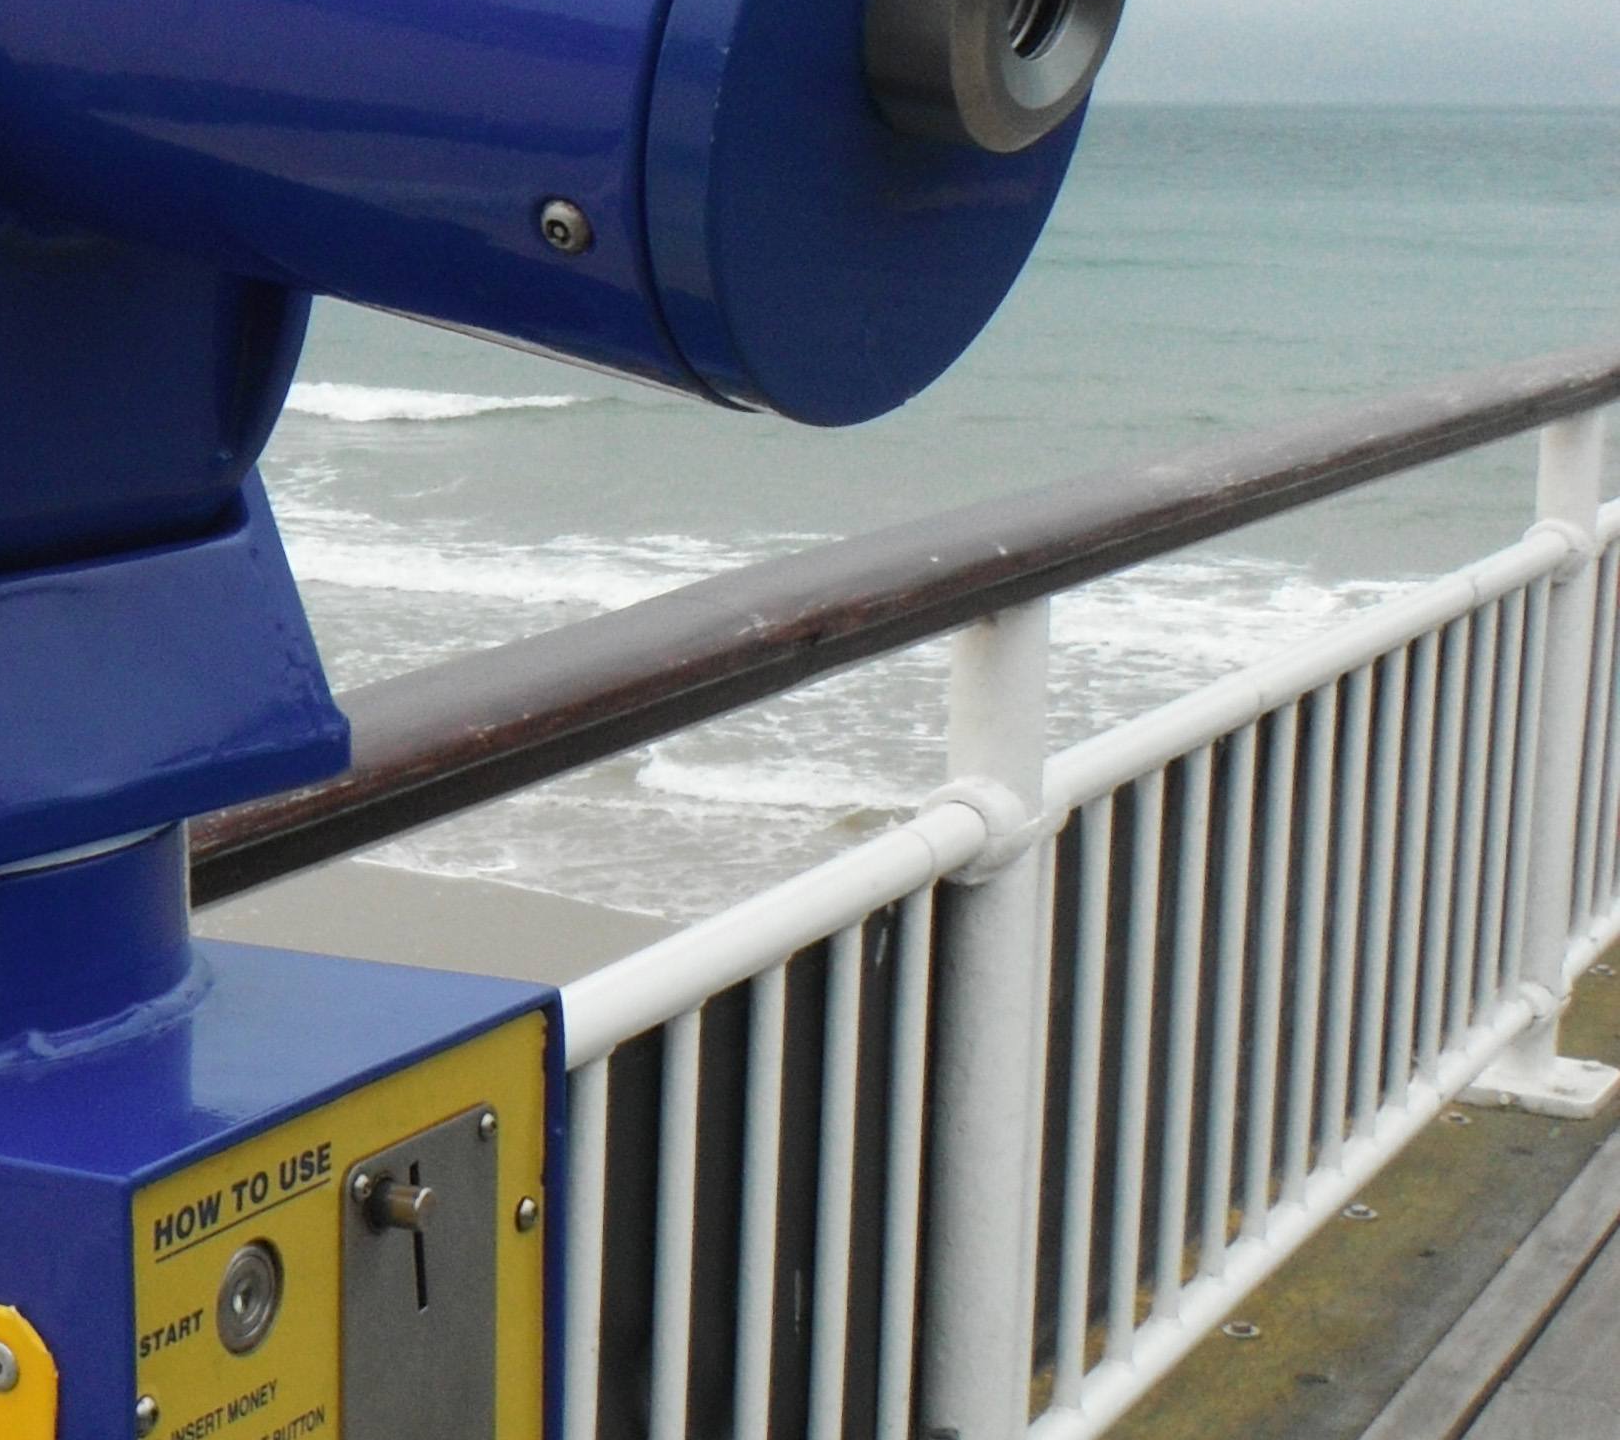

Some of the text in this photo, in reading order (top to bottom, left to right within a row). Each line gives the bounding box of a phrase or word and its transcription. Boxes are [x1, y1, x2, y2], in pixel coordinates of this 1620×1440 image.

[154, 1142, 331, 1251] HOW TO USE
[139, 1309, 203, 1358] START
[228, 1380, 278, 1423] MONEY
